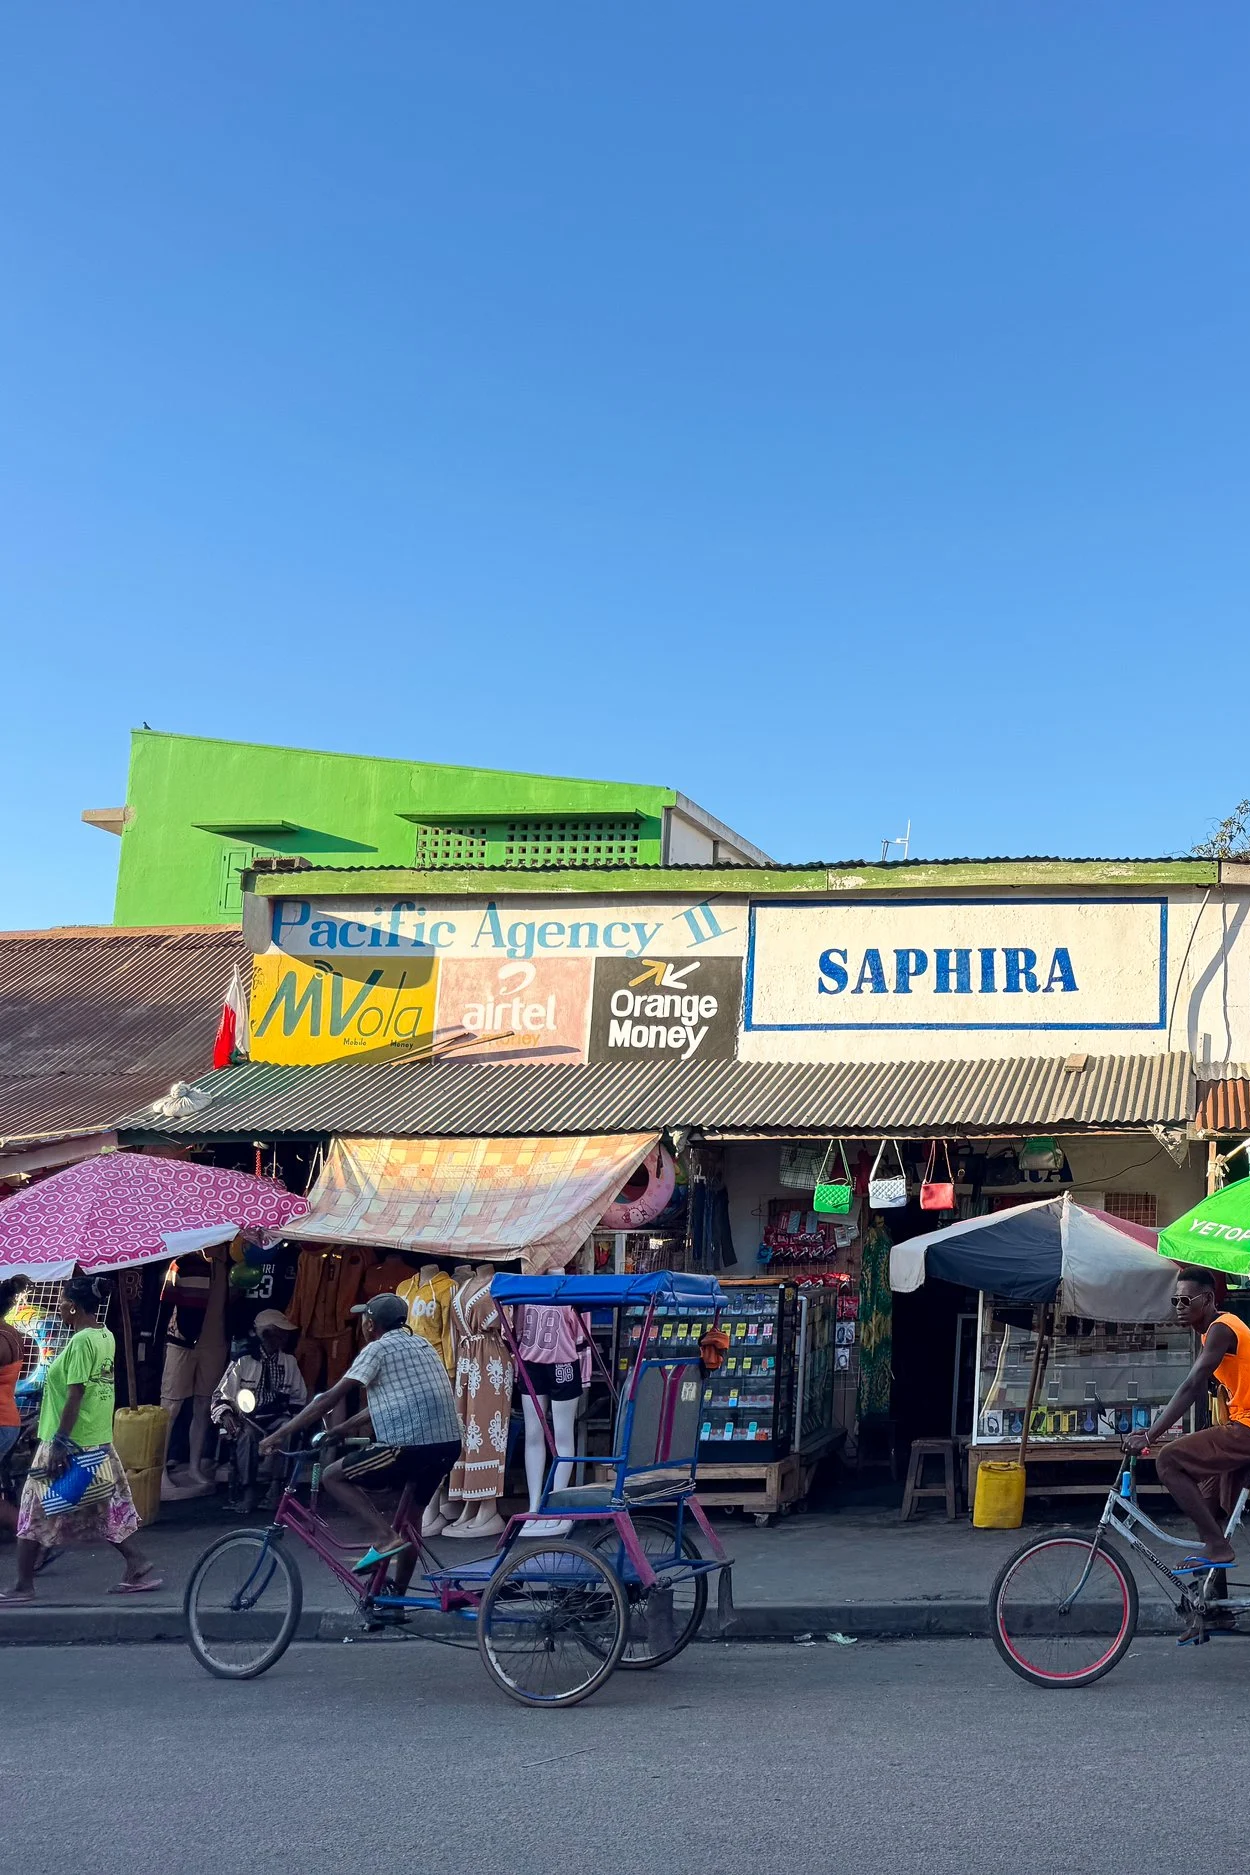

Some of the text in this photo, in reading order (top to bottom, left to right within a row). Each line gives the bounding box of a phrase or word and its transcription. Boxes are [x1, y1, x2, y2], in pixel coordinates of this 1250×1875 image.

[272, 892, 738, 959] Pacific Agency II
[818, 947, 1079, 995] SAPHIRA
[254, 969, 423, 1037] MVola
[461, 993, 557, 1031] airtel
[610, 989, 718, 1026] Orange
[608, 1020, 709, 1060] Money
